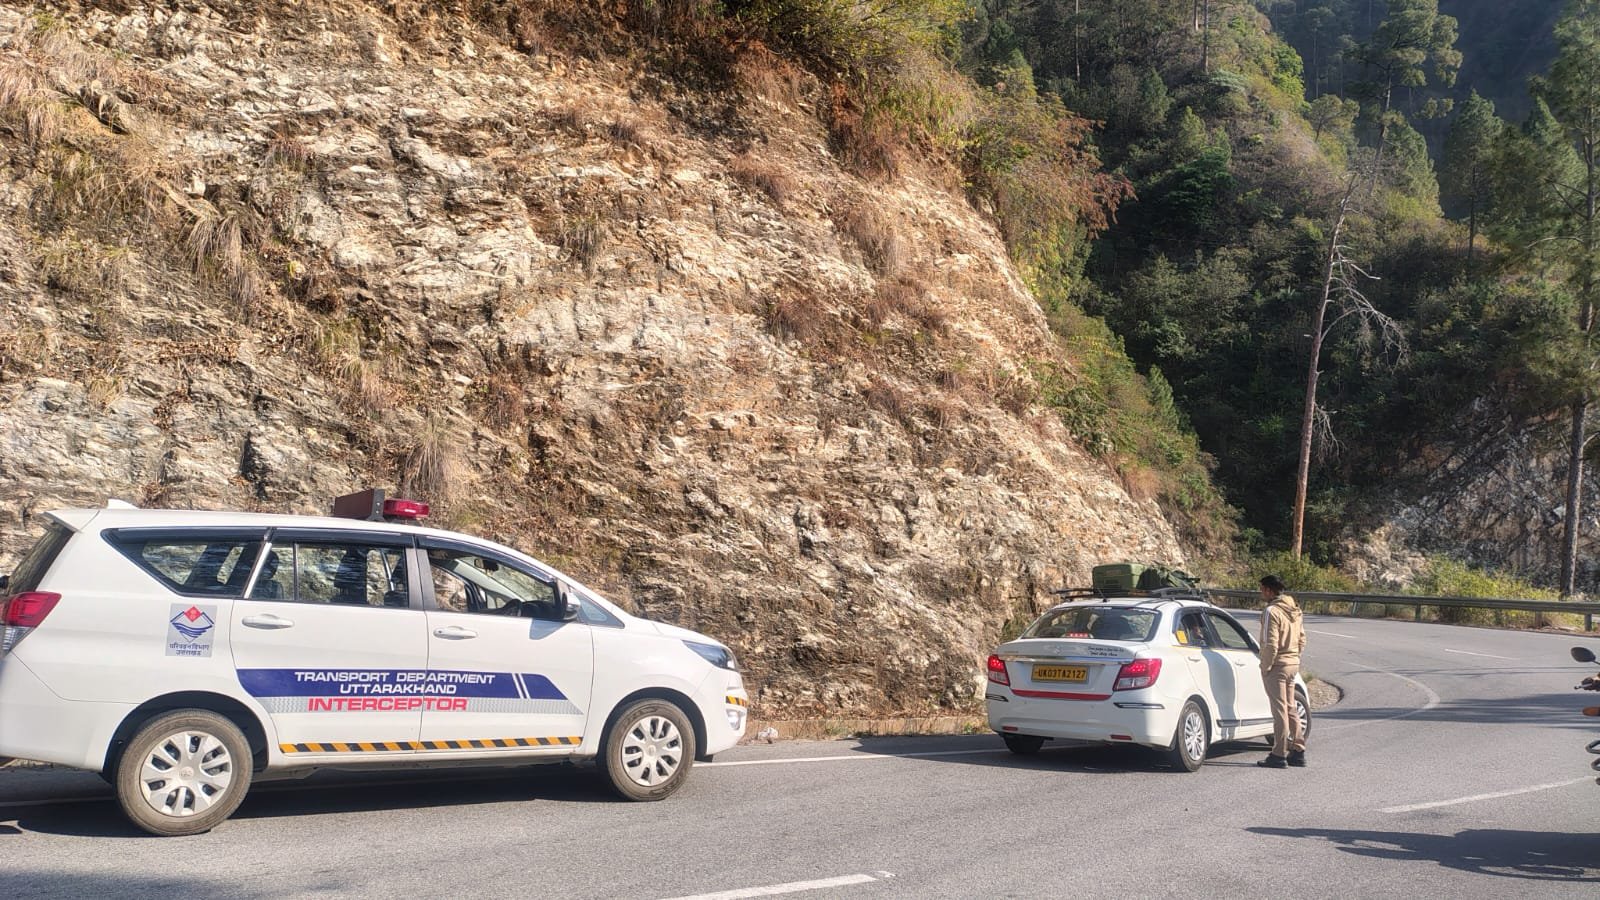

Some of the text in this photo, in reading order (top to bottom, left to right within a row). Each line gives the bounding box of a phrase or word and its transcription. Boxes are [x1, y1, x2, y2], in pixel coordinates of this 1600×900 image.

[294, 672, 496, 684] TRANSPORT DEPARTMENT
[340, 684, 457, 694] UTTARAKHAND
[308, 697, 468, 712] INTERCEPTOR
